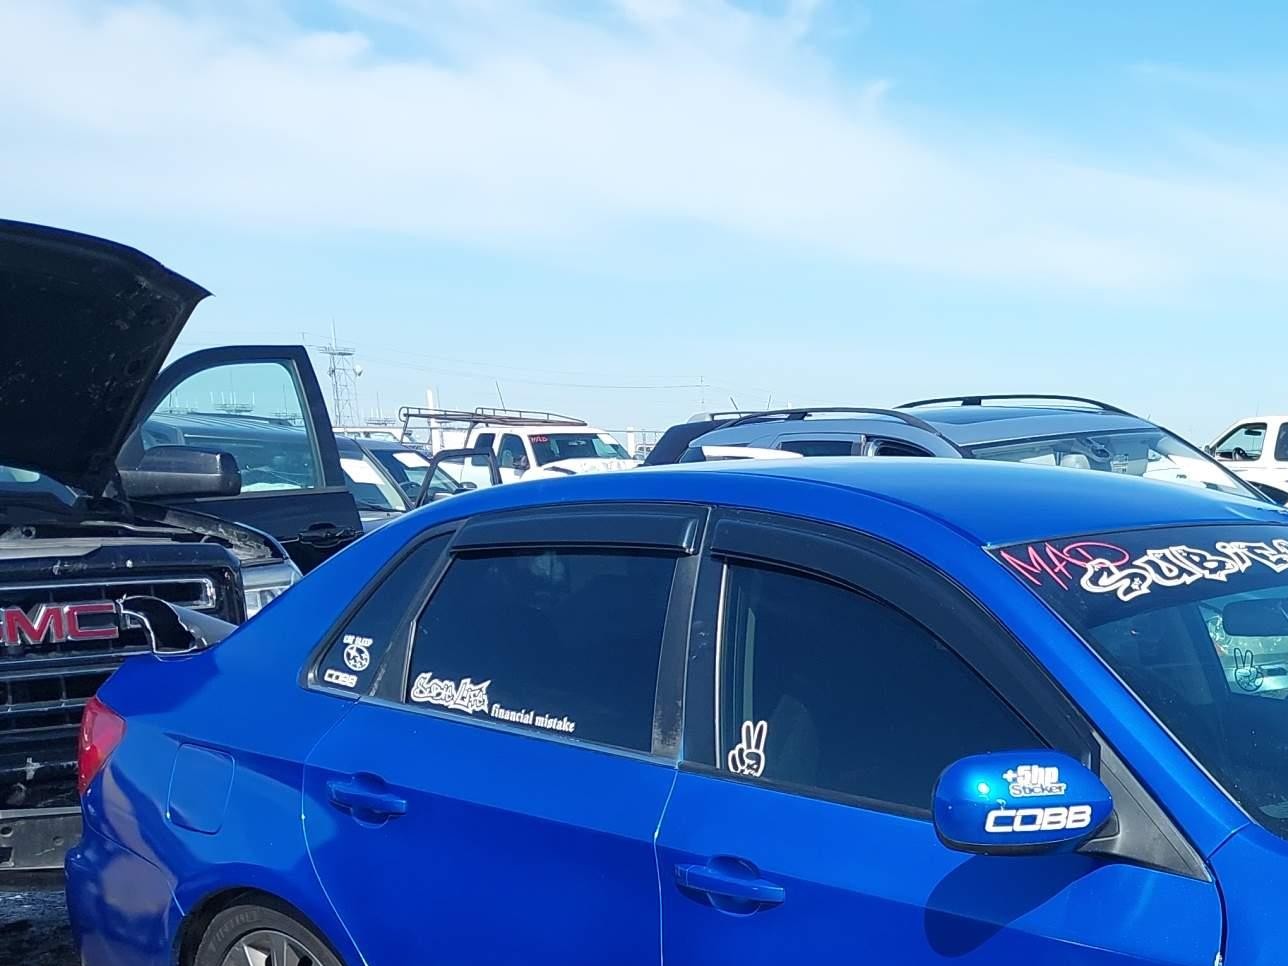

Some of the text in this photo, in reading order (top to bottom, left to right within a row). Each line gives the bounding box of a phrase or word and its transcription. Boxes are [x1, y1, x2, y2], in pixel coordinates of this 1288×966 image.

[0, 602, 119, 646] MC
[491, 704, 576, 733] financial mistake
[1009, 784, 1067, 797] Sticker
[985, 805, 1092, 833] COBB
